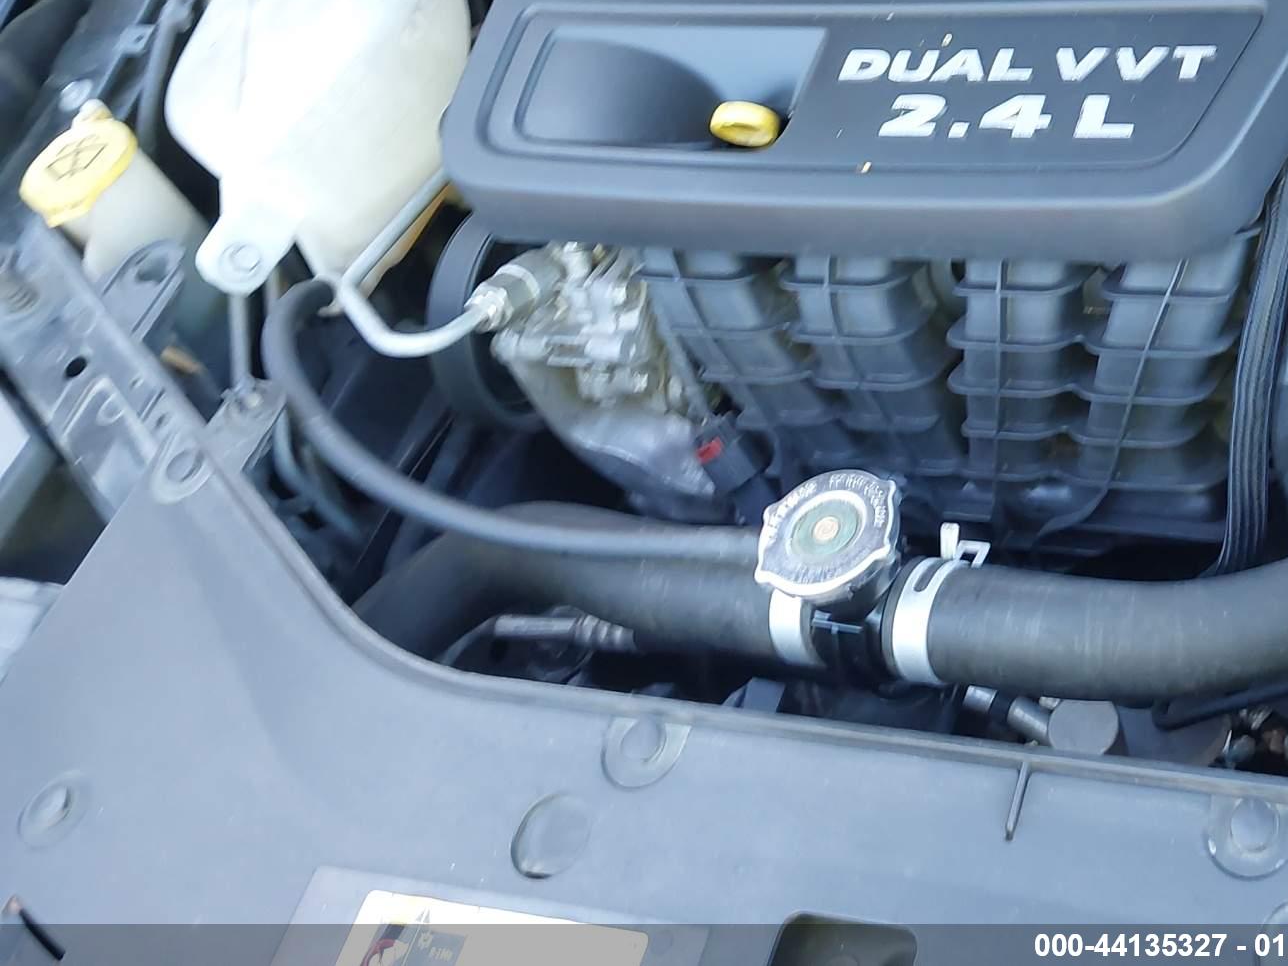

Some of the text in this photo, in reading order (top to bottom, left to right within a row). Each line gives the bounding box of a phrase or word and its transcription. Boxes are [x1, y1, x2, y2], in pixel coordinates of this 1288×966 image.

[838, 44, 1218, 83] DUAL VVT
[877, 93, 1136, 139] 2.4 L
